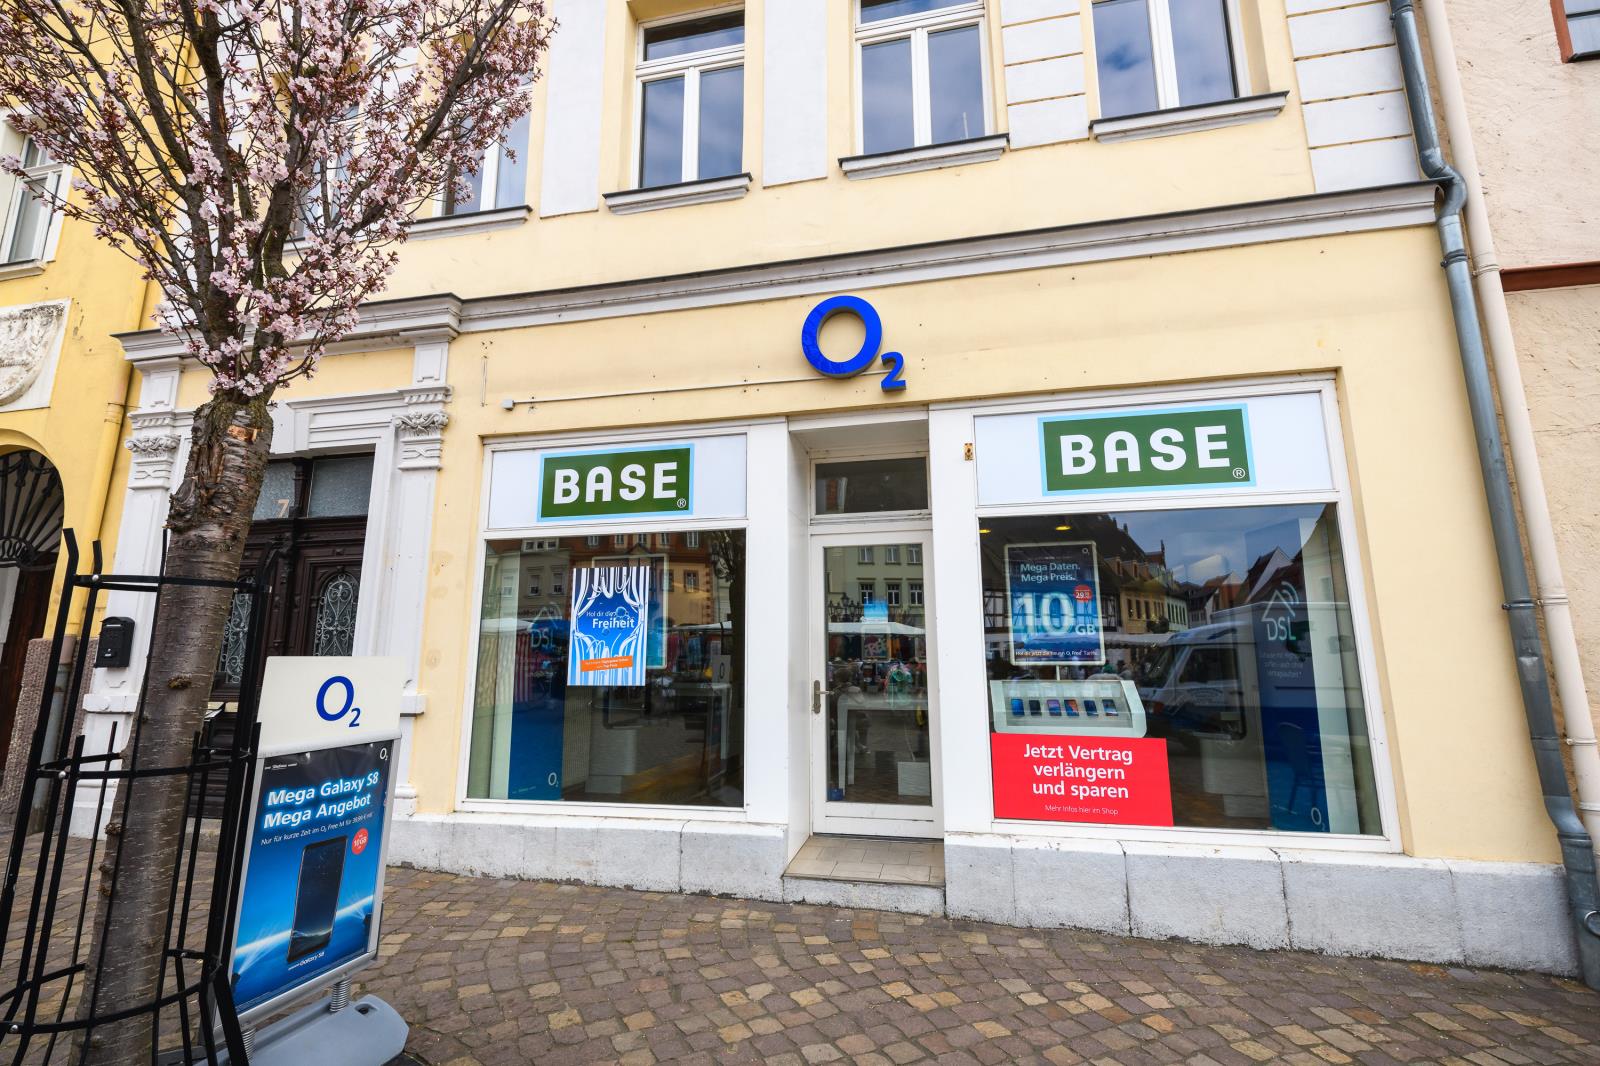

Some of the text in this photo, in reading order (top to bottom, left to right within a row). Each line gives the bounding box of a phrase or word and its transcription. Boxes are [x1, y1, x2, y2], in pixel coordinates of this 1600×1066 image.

[1060, 425, 1230, 475] BASE
[553, 462, 677, 504] BASE
[1020, 562, 1081, 572] Mega Daten.
[1021, 572, 1076, 583] Mega Preis.
[592, 617, 635, 629] Freiheit
[1020, 592, 1074, 636] 10
[1075, 624, 1096, 635] GB
[1266, 616, 1297, 640] DSL
[315, 675, 361, 728] O2
[1023, 743, 1133, 765] Jetzt Vertrag
[1033, 762, 1125, 782] verlängern
[267, 771, 379, 806] Mega Galaxy S8
[1032, 781, 1129, 800] und sparen
[263, 794, 371, 829] Mega Angebot
[1044, 804, 1062, 812] Mehr
[1062, 805, 1078, 813] Infos
[1078, 806, 1091, 814] hier
[1101, 807, 1118, 816] Shop
[261, 837, 272, 846] Nur
[283, 832, 300, 840] kurze
[300, 829, 311, 837] Zeit
